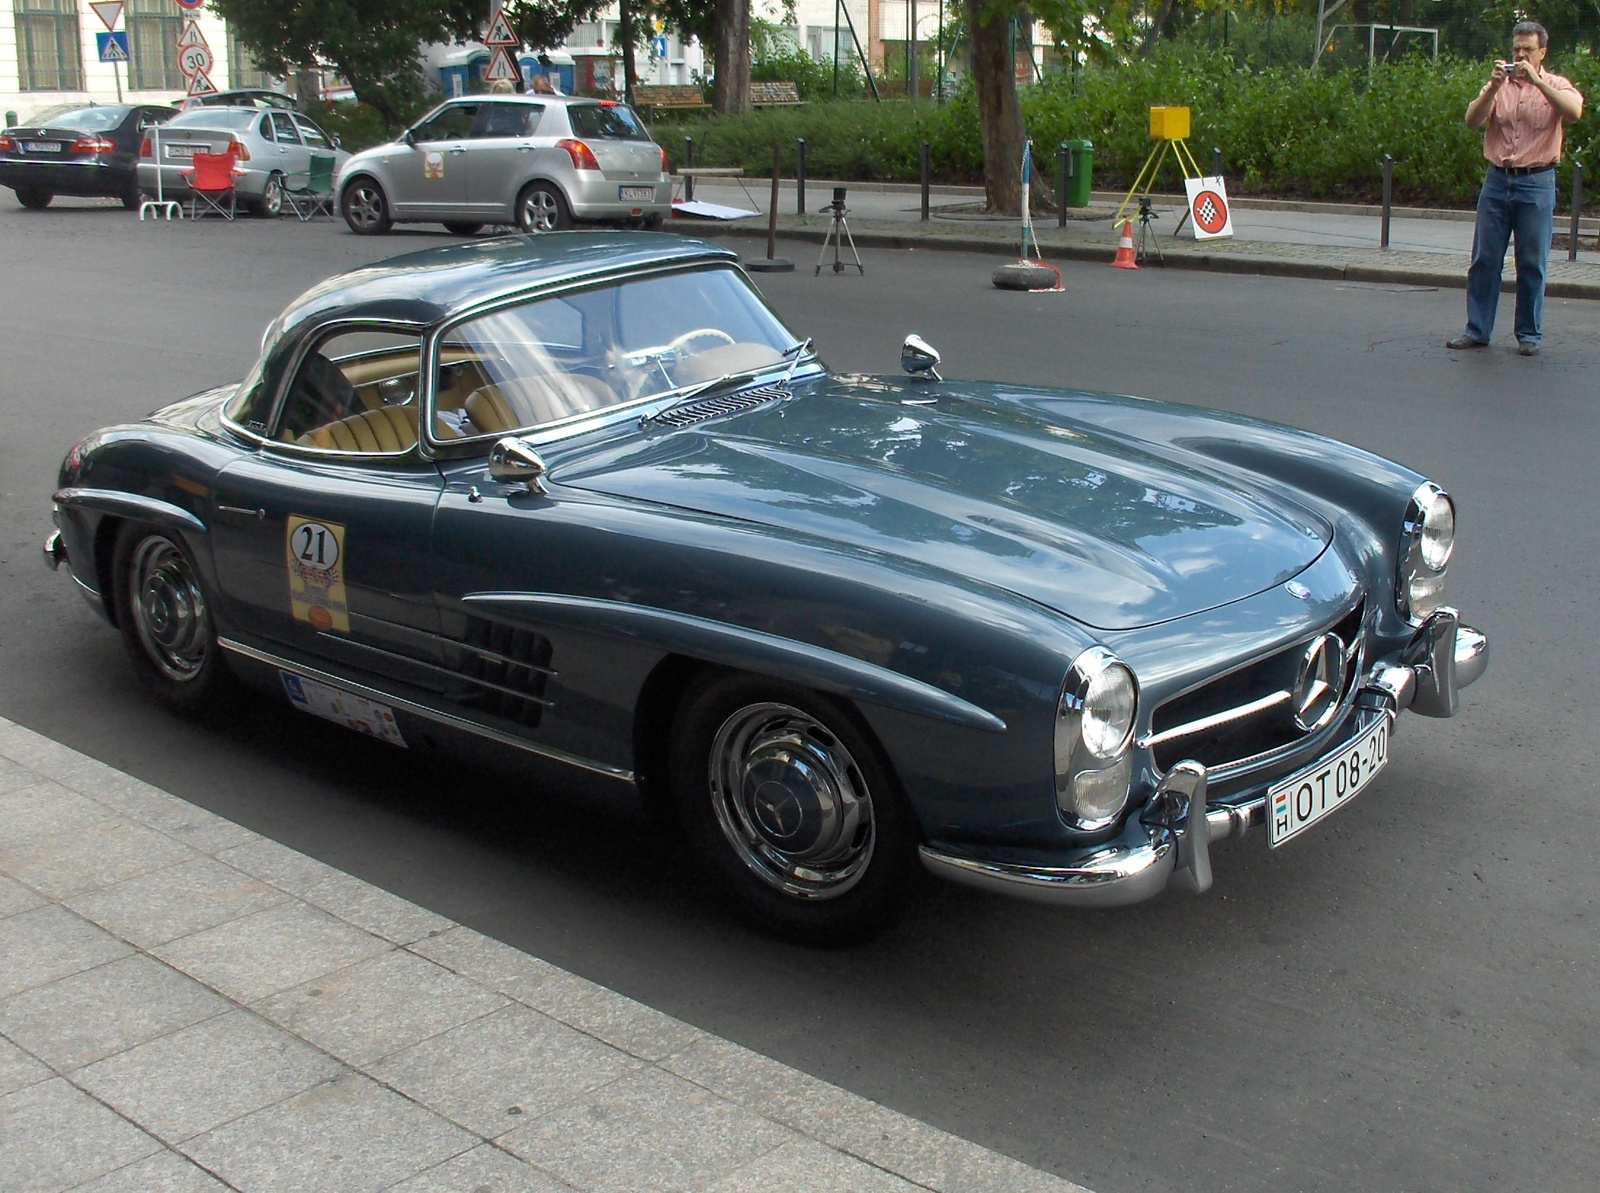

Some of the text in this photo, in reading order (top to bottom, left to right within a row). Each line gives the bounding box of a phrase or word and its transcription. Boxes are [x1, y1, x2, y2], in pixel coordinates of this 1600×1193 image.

[187, 53, 205, 69] 30
[301, 526, 326, 564] 21
[1296, 726, 1386, 822] OT 08-20
[1276, 814, 1288, 836] H
